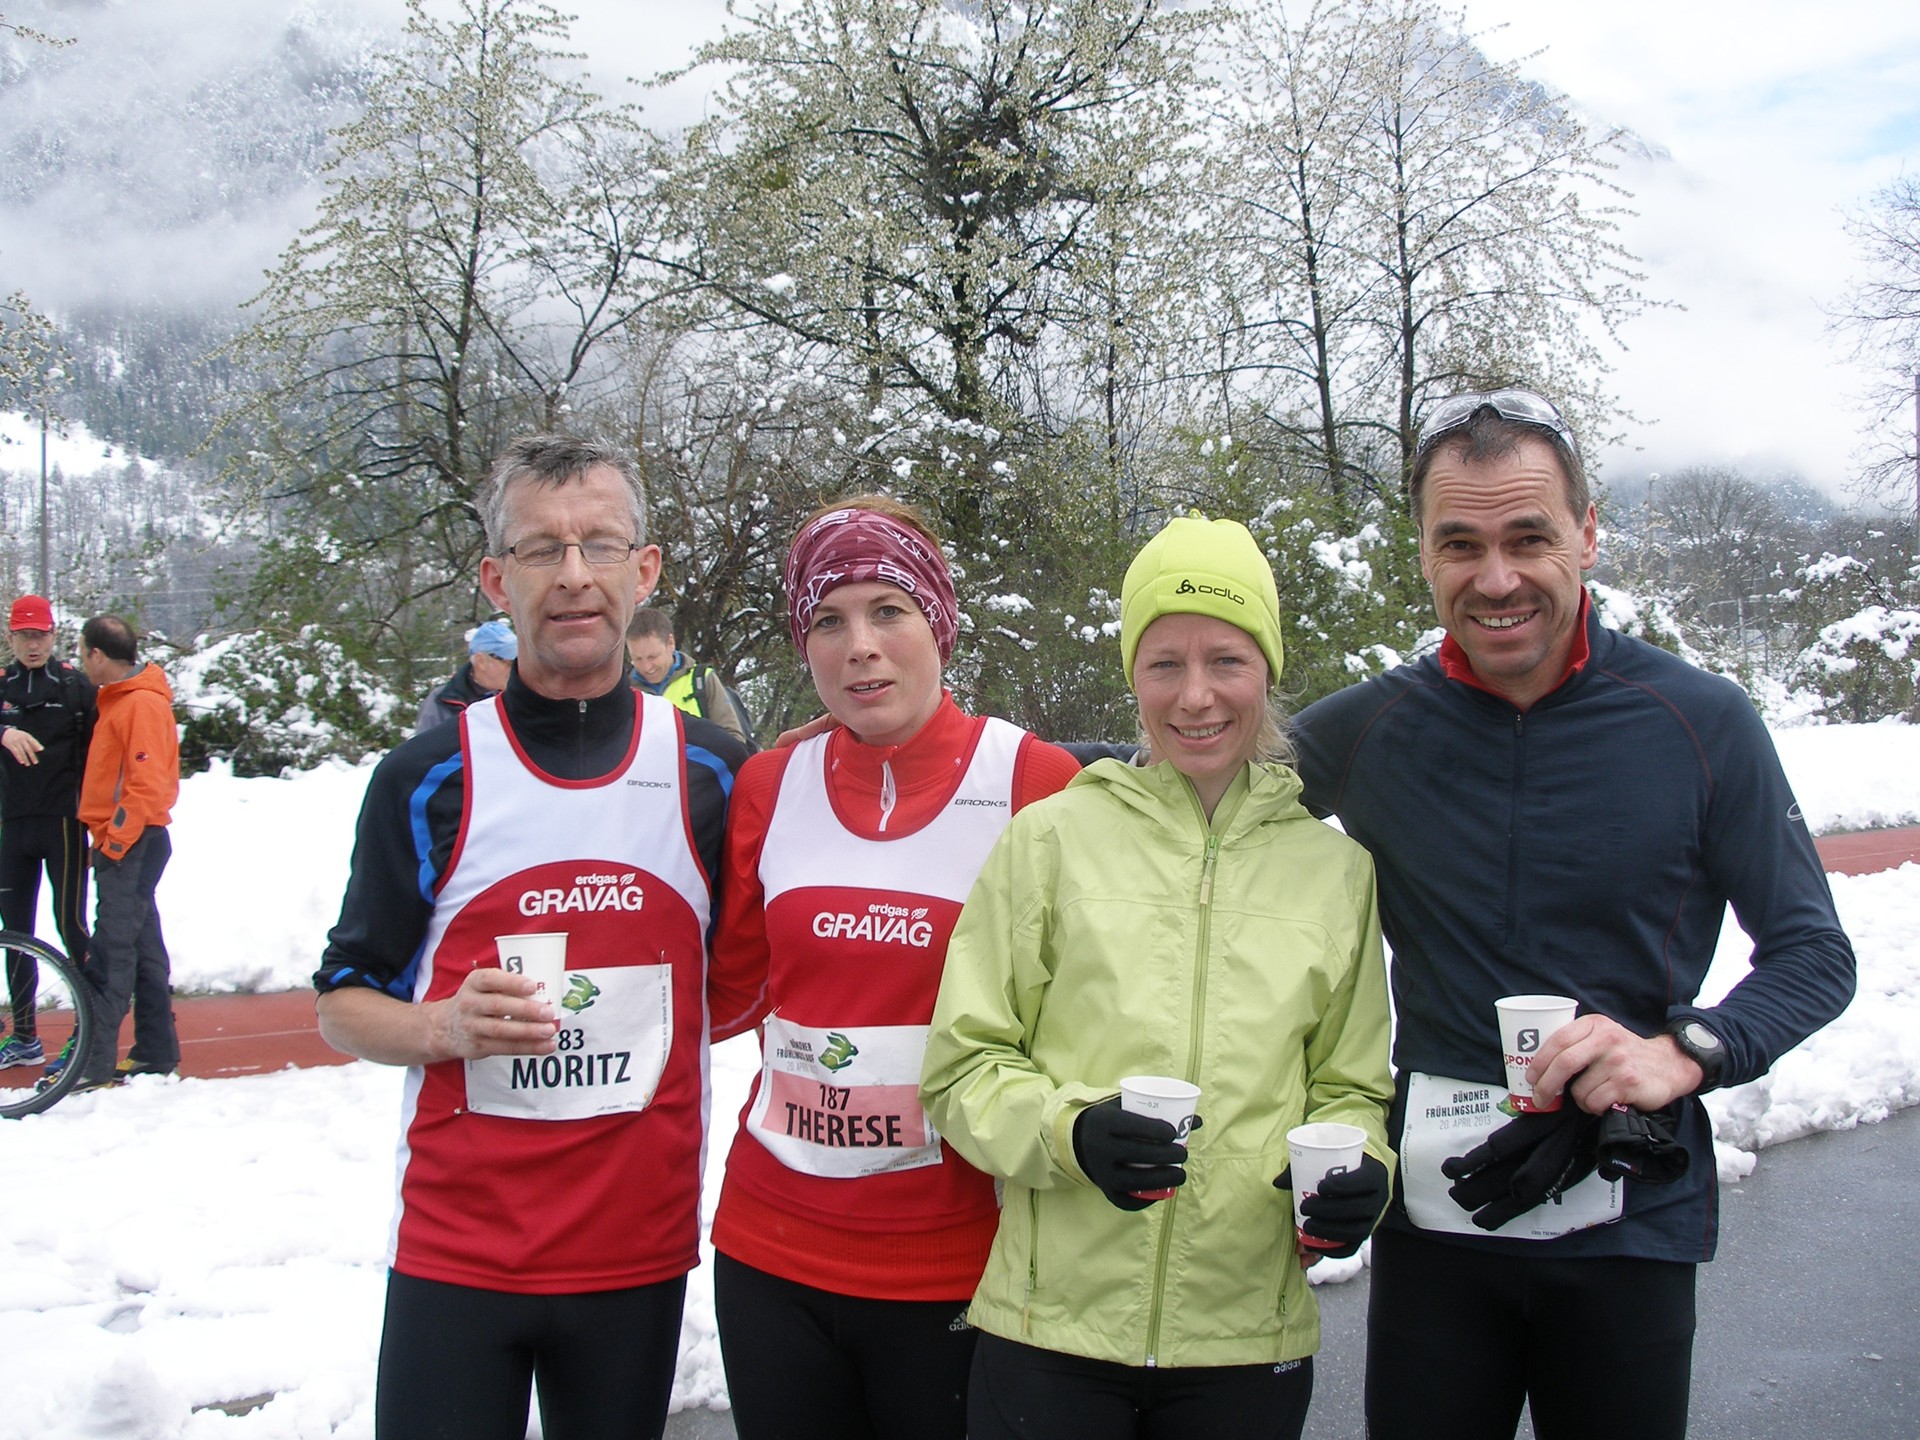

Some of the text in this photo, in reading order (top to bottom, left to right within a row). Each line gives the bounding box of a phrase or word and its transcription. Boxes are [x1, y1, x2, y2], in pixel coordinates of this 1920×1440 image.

[1198, 585, 1245, 605] odlo
[626, 779, 672, 789] BROOKS
[954, 799, 1008, 808] BROOKS
[575, 872, 618, 887] erdgas
[518, 884, 644, 917] GRAVAG
[868, 902, 910, 917] erdgas
[812, 911, 933, 948] GRAVAG
[558, 1028, 585, 1051] 83
[511, 1051, 632, 1090] MORITZ
[819, 1084, 851, 1111] 187
[1453, 1089, 1490, 1103] BÜNDNER
[1425, 1102, 1490, 1118] FRÜHLINGSLAUF
[785, 1101, 903, 1148] THERESE
[1452, 1117, 1471, 1129] APRIL
[1474, 1115, 1491, 1127] 2013
